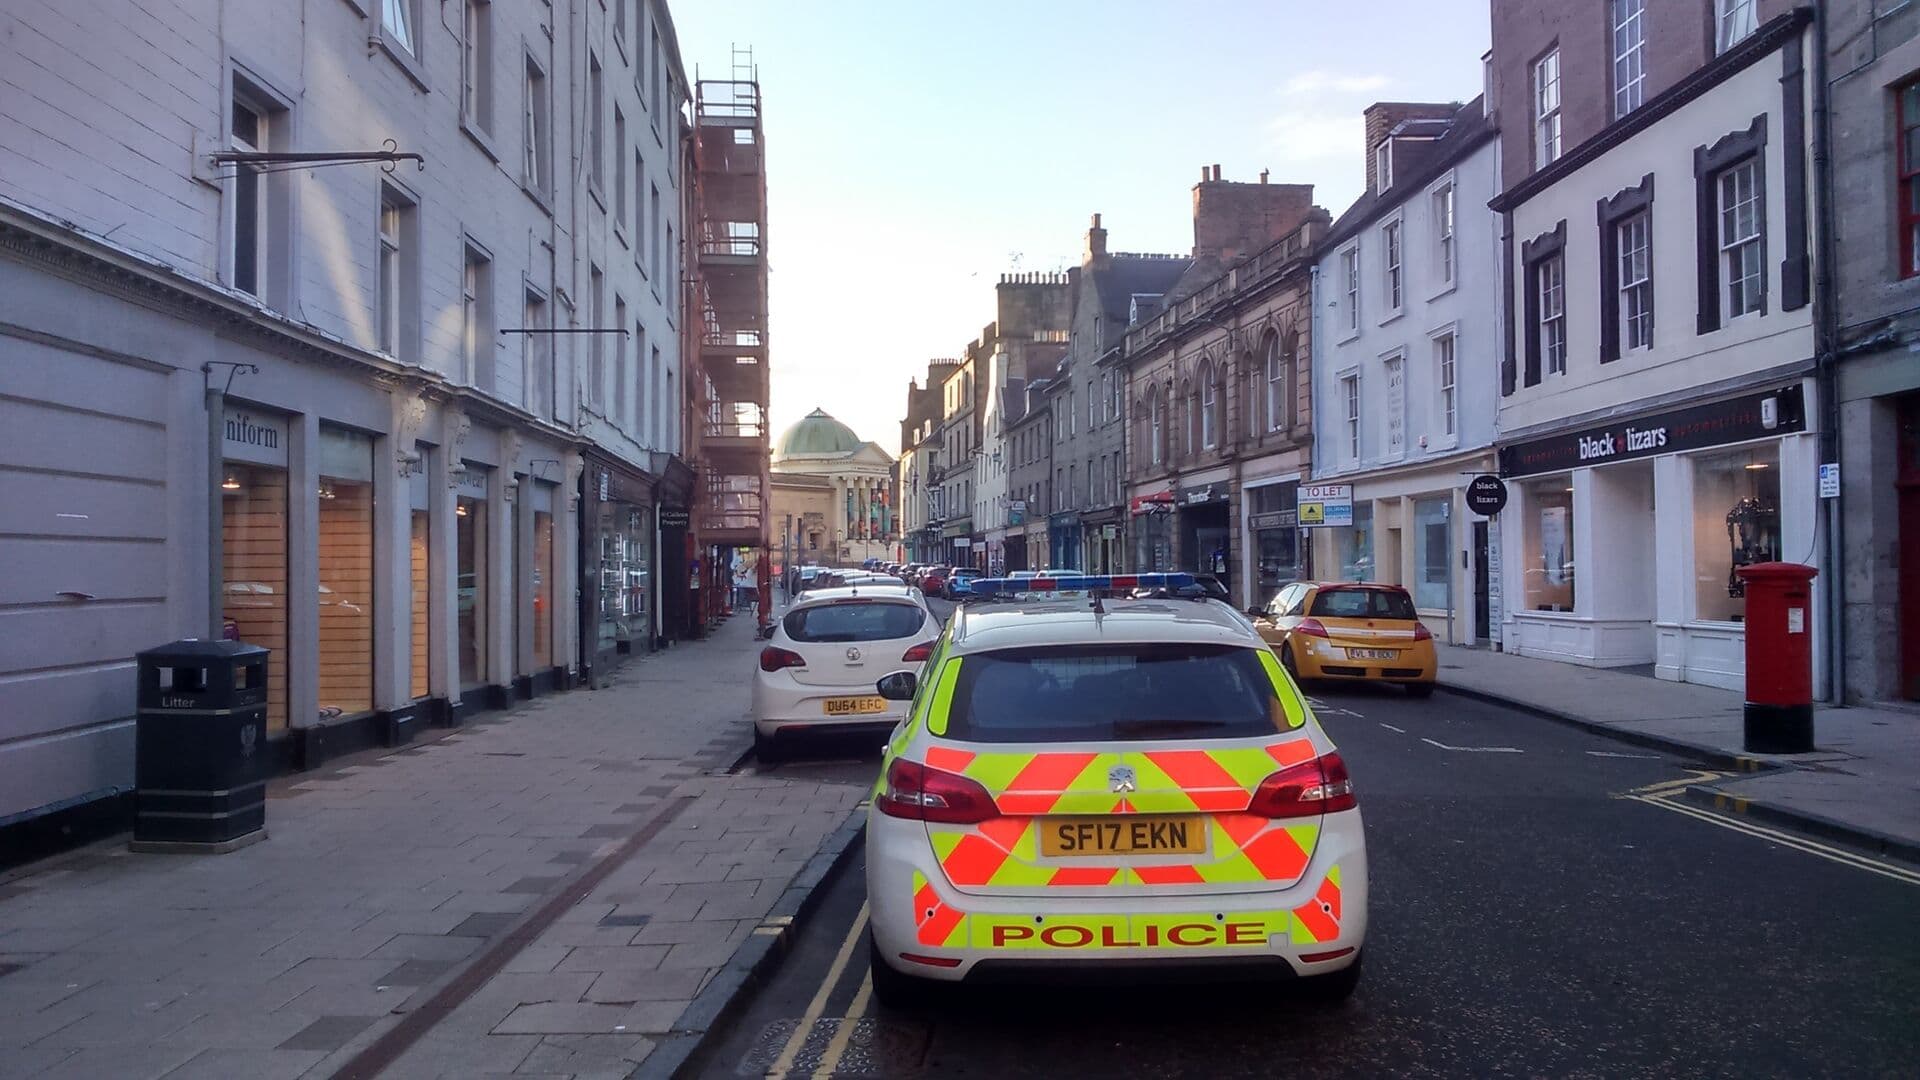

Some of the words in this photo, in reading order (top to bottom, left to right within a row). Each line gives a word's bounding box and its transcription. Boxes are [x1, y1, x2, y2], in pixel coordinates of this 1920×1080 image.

[225, 413, 278, 449] niform
[1579, 433, 1615, 460] black
[1625, 427, 1667, 451] lizars
[1306, 487, 1320, 497] TO
[1322, 486, 1343, 497] LET
[1476, 481, 1498, 490] black
[1476, 495, 1498, 503] lizars
[162, 697, 195, 708] Litter
[827, 700, 857, 712] DU64
[859, 699, 882, 710] EFC
[1058, 824, 1122, 850] SF17
[1131, 822, 1188, 849] EKN
[992, 922, 1268, 947] POLICE
